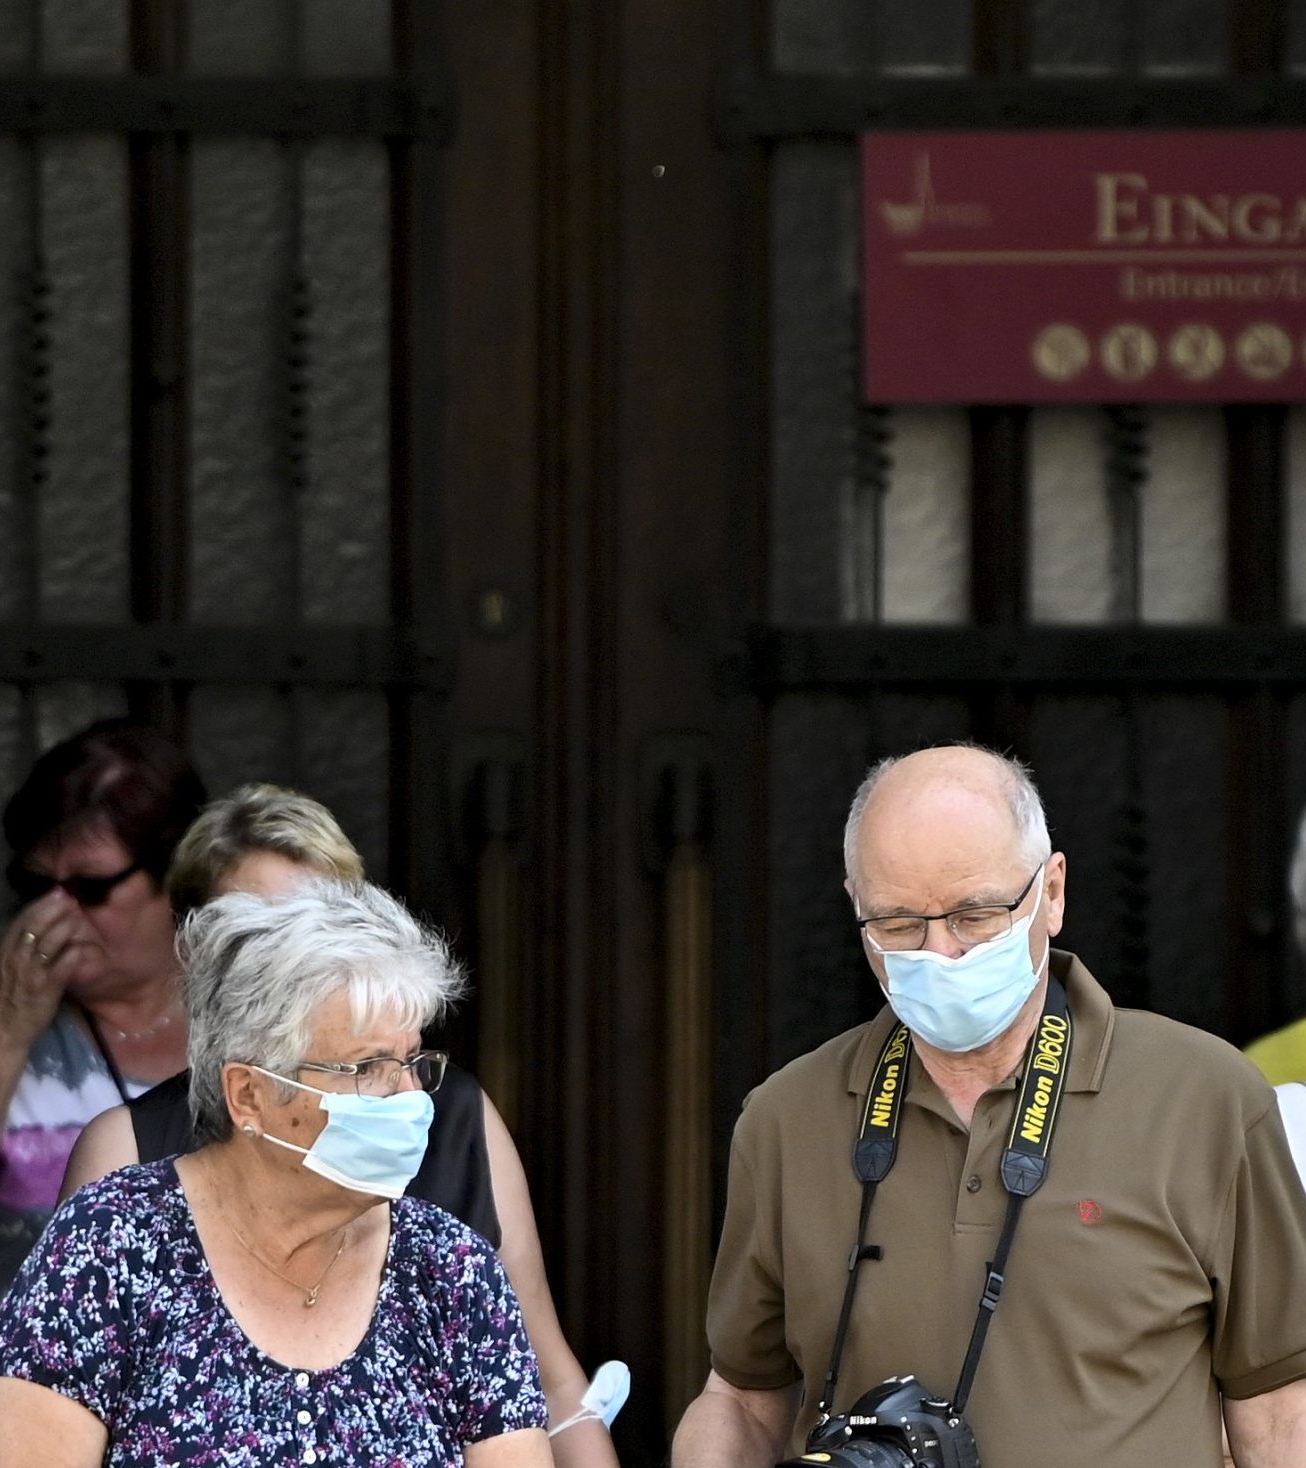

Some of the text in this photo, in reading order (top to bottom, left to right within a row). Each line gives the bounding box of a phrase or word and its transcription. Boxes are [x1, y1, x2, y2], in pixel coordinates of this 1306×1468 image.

[870, 1064, 900, 1128] Nikon
[1020, 1014, 1068, 1144] Nikon D600
[849, 1415, 877, 1426] Nikon
